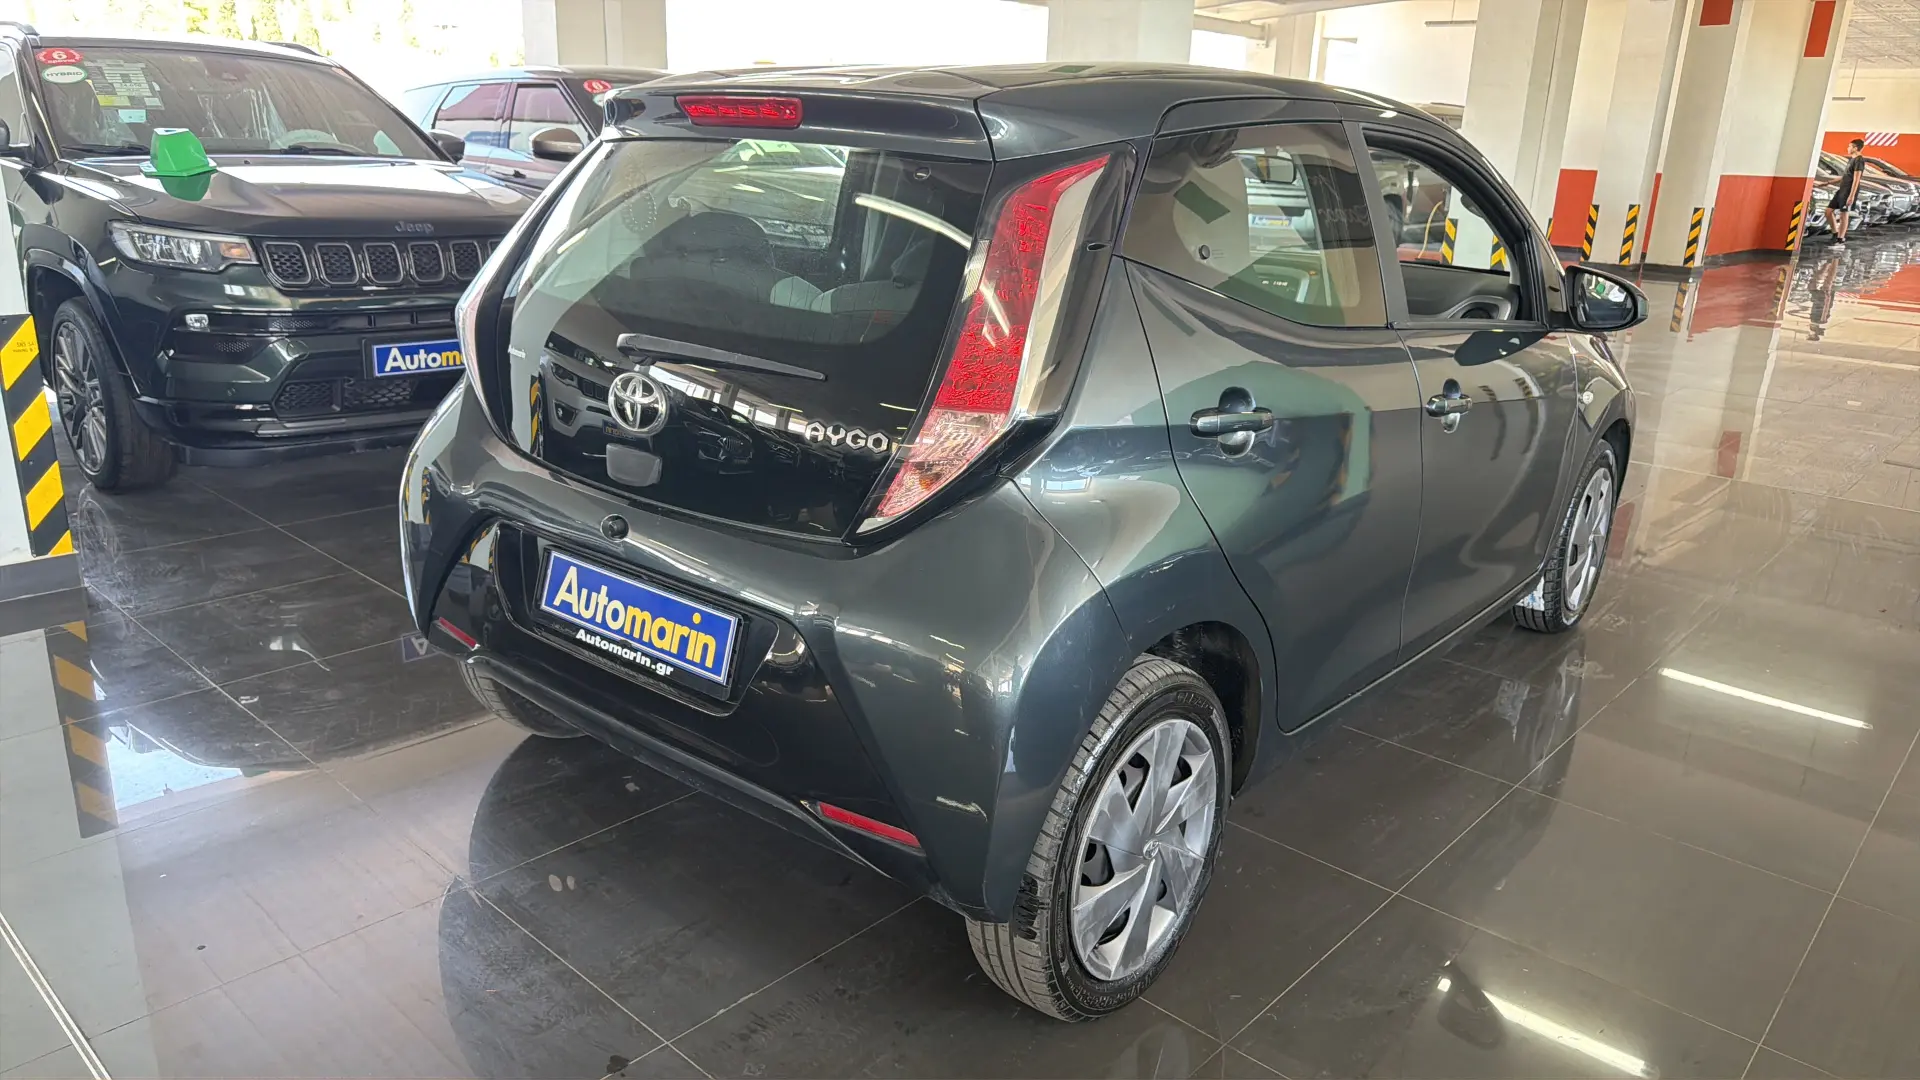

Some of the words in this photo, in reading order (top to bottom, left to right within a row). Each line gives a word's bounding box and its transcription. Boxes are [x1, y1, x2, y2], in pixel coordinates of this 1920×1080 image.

[52, 51, 67, 60] 6
[395, 220, 434, 234] Jeep
[384, 347, 466, 372] Autom
[804, 420, 890, 455] AYGO
[552, 565, 717, 669] Automarin
[575, 628, 675, 677] Automarin.gr
